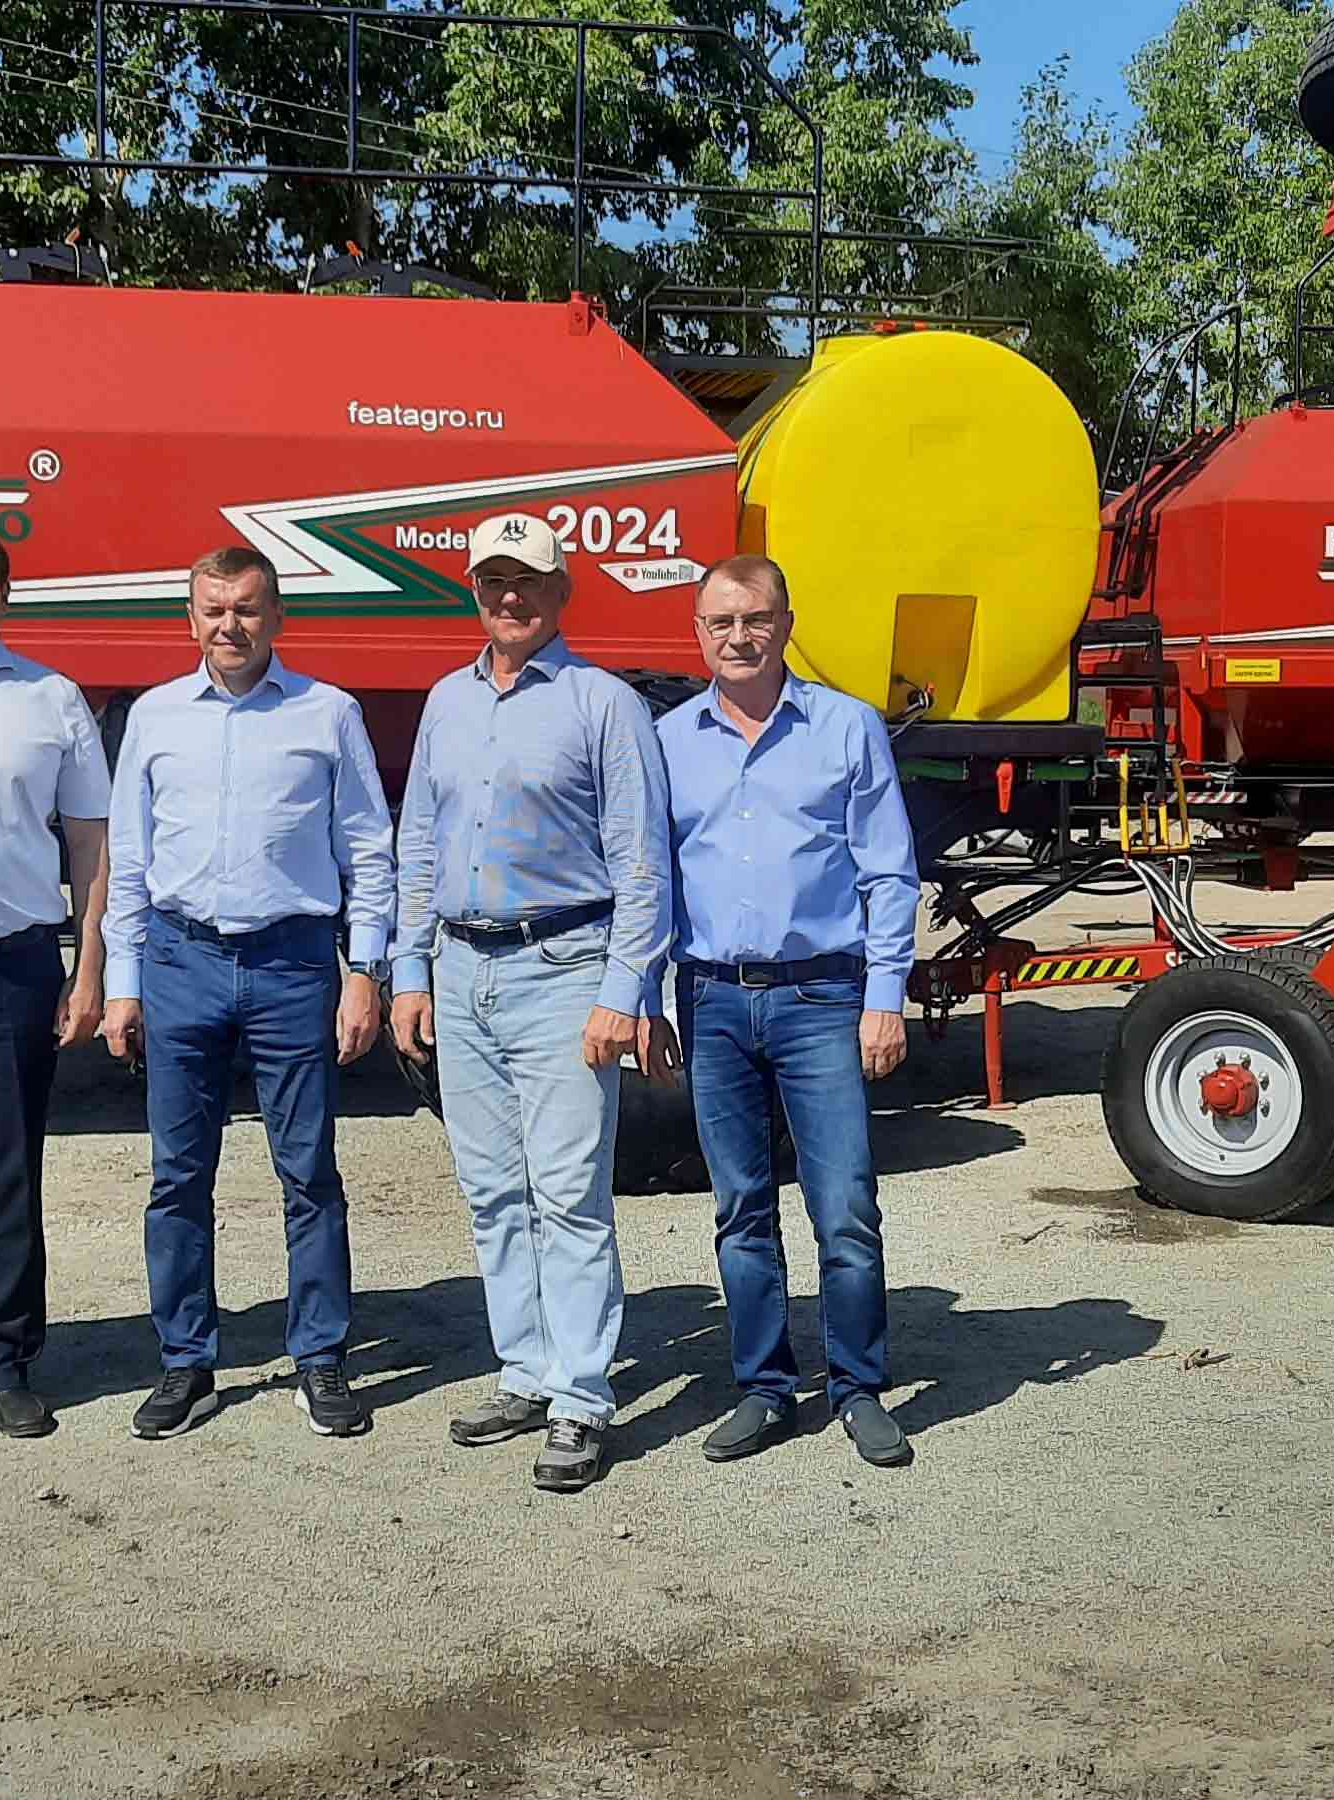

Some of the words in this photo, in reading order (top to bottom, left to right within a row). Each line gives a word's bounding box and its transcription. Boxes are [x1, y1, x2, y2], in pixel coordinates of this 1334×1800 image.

[348, 400, 503, 431] featagro.ru
[395, 526, 475, 550] Model
[547, 504, 681, 556] 2024
